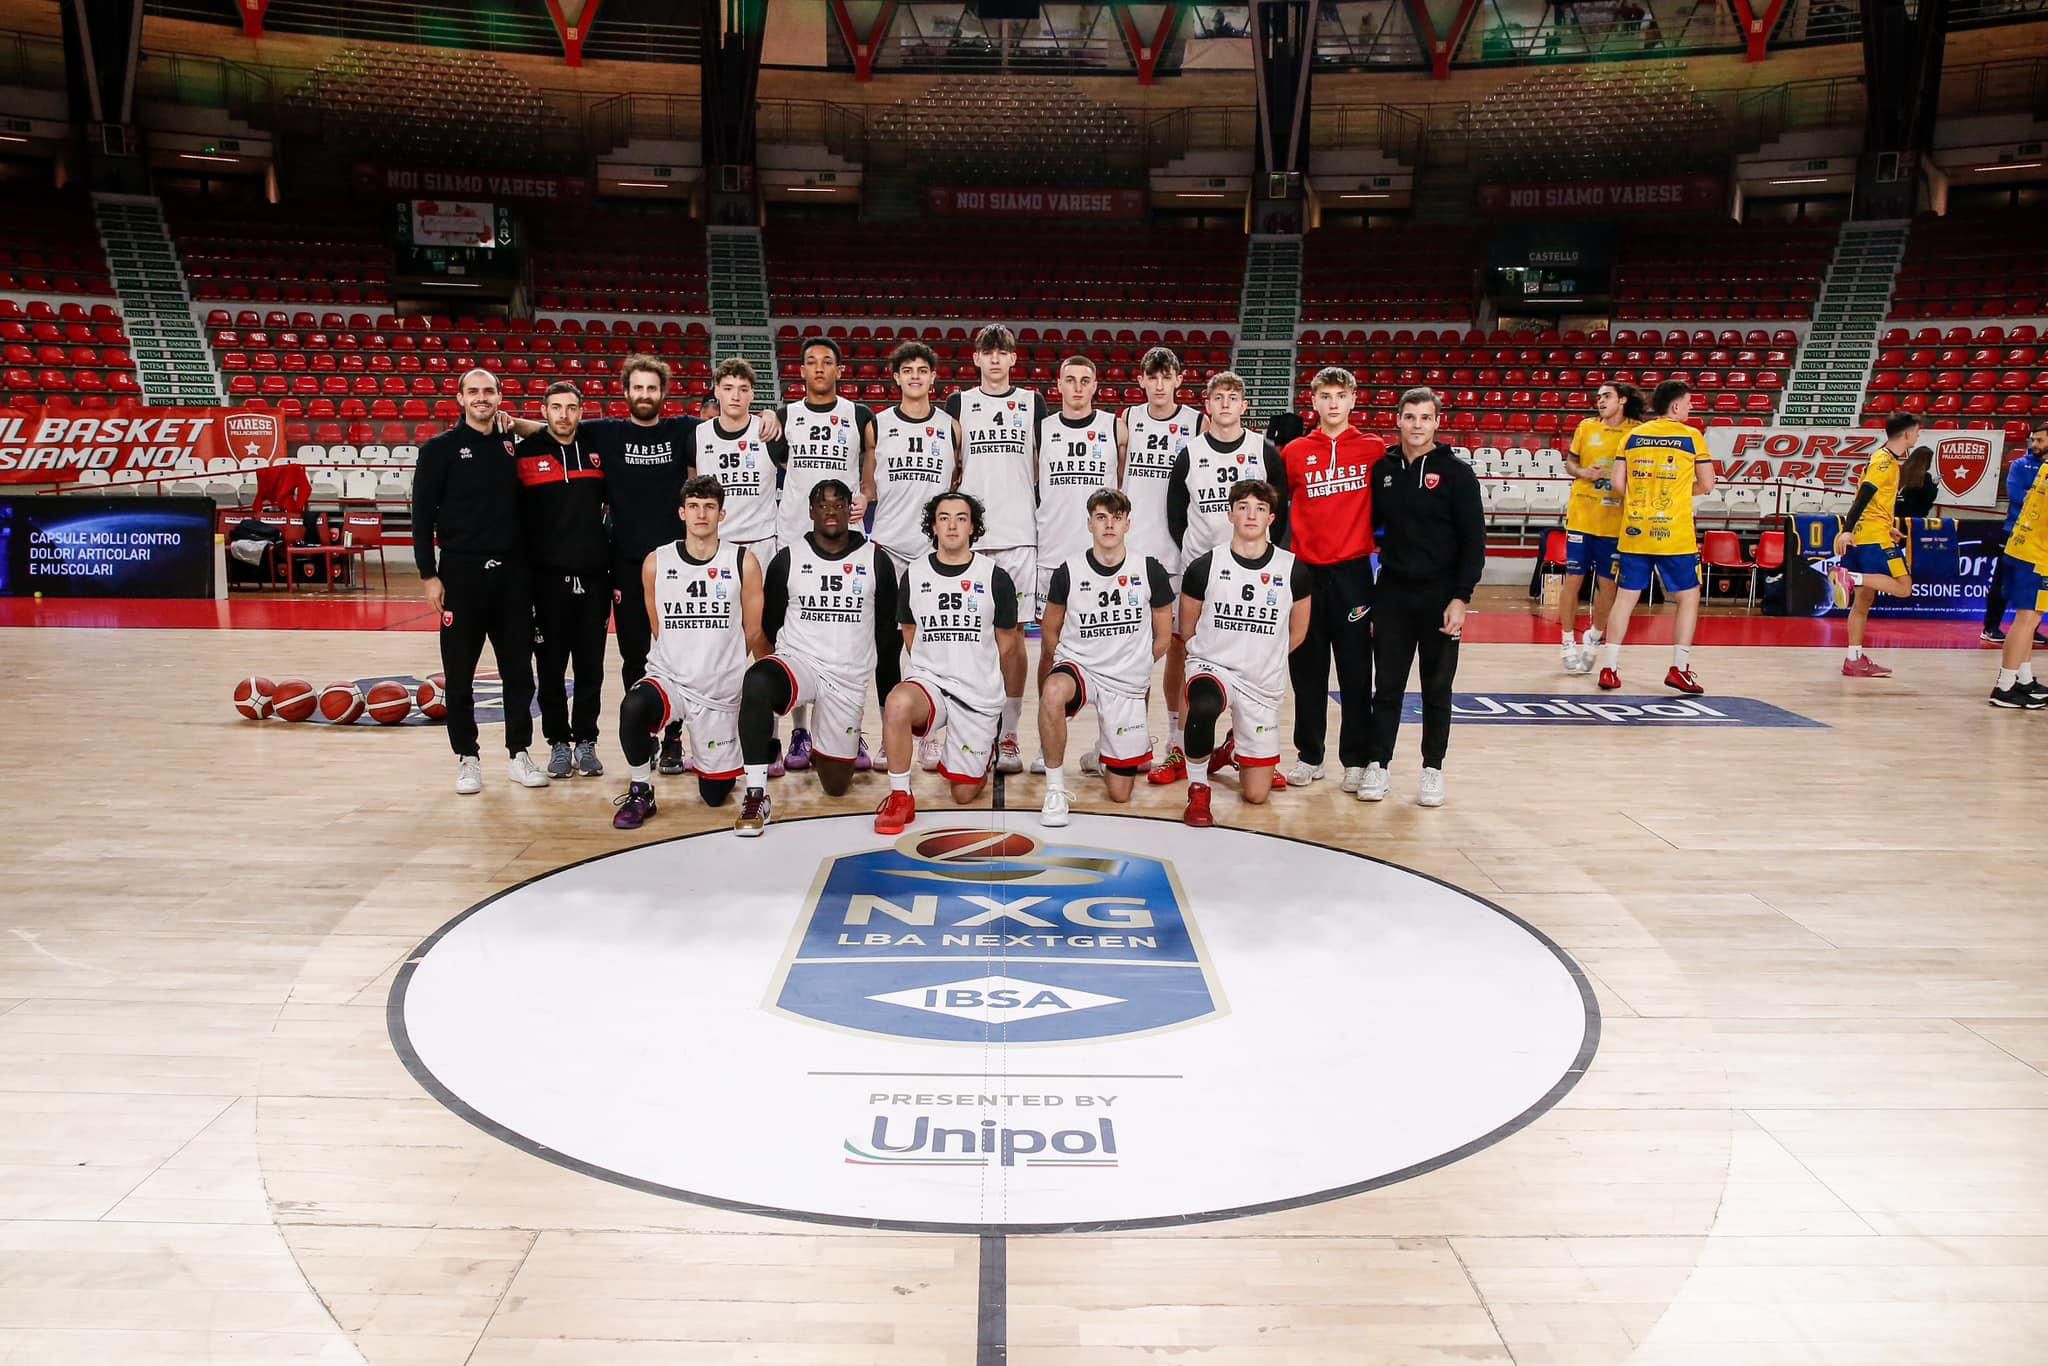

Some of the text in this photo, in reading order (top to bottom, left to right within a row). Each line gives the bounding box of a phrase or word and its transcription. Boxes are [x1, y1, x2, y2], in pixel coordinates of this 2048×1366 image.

[387, 170, 558, 198] NOI SIAMO VARESE
[956, 192, 1112, 211] NOI SIAMO VARESE
[1510, 184, 1683, 208] NOI SIAMO VARESE
[1529, 252, 1579, 262] CASTELLO
[228, 419, 272, 430] VARESE
[993, 411, 1004, 426] 4
[33, 418, 214, 444] BASKET
[810, 426, 832, 441] 23
[970, 429, 1026, 442] VARESE
[625, 441, 672, 455] VARESE
[908, 438, 924, 453] 11
[970, 444, 1024, 454] BASKETBALL
[1067, 442, 1087, 457] 10
[1147, 434, 1169, 450] 24
[1643, 440, 1682, 448] GIVOVA
[1732, 433, 1907, 459] FORZ
[1942, 443, 1986, 454] VARESE
[0, 447, 195, 470] SIAMO NOI
[792, 444, 848, 458] VARESE
[625, 455, 672, 466] BASKETBALL
[719, 453, 740, 468] 35
[794, 460, 848, 472] BASKETBALL
[888, 456, 944, 470] VARESE
[1050, 460, 1106, 472] VARESE
[1130, 452, 1176, 466] VARES
[722, 472, 760, 484] RESE
[889, 472, 941, 484] BASKETBALL
[1217, 466, 1238, 483] 33
[1305, 464, 1368, 484] VARESE
[1711, 460, 1874, 485] VARES
[1050, 476, 1104, 486] BASKETBALL
[1307, 479, 1368, 498] BASKETBALL
[1198, 487, 1226, 500] VAR
[1200, 504, 1231, 514] BASKE
[30, 532, 181, 546] CAPSULE MOLLI CONTRO
[1810, 522, 1824, 548] 0
[30, 548, 150, 560] DOLORI ARTICOLARI
[30, 564, 113, 576] E MUSCOLARI
[686, 580, 708, 598] 41
[820, 575, 843, 592] 15
[1912, 584, 1961, 597] SSIONE
[1098, 588, 1122, 608] 34
[1241, 584, 1255, 601] 6
[664, 602, 731, 614] VARESE
[798, 595, 864, 608] VARESE
[938, 592, 962, 610] 25
[800, 612, 862, 623] BASKETBALL
[1079, 608, 1142, 624] VARESE
[1214, 602, 1279, 620] VARESE
[664, 619, 730, 630] BASKETBALL
[920, 614, 982, 628] VARESE
[1214, 620, 1276, 636] BASKETBALL
[922, 632, 980, 642] BASKETBALL
[1451, 696, 1729, 722] Unipol
[843, 894, 1156, 929] NXG
[837, 933, 1158, 949] LBA NEXTGEN
[924, 988, 1074, 1010] IBSA
[868, 1093, 1119, 1108] PRESENTED BY
[870, 1116, 1118, 1168] Unipol
